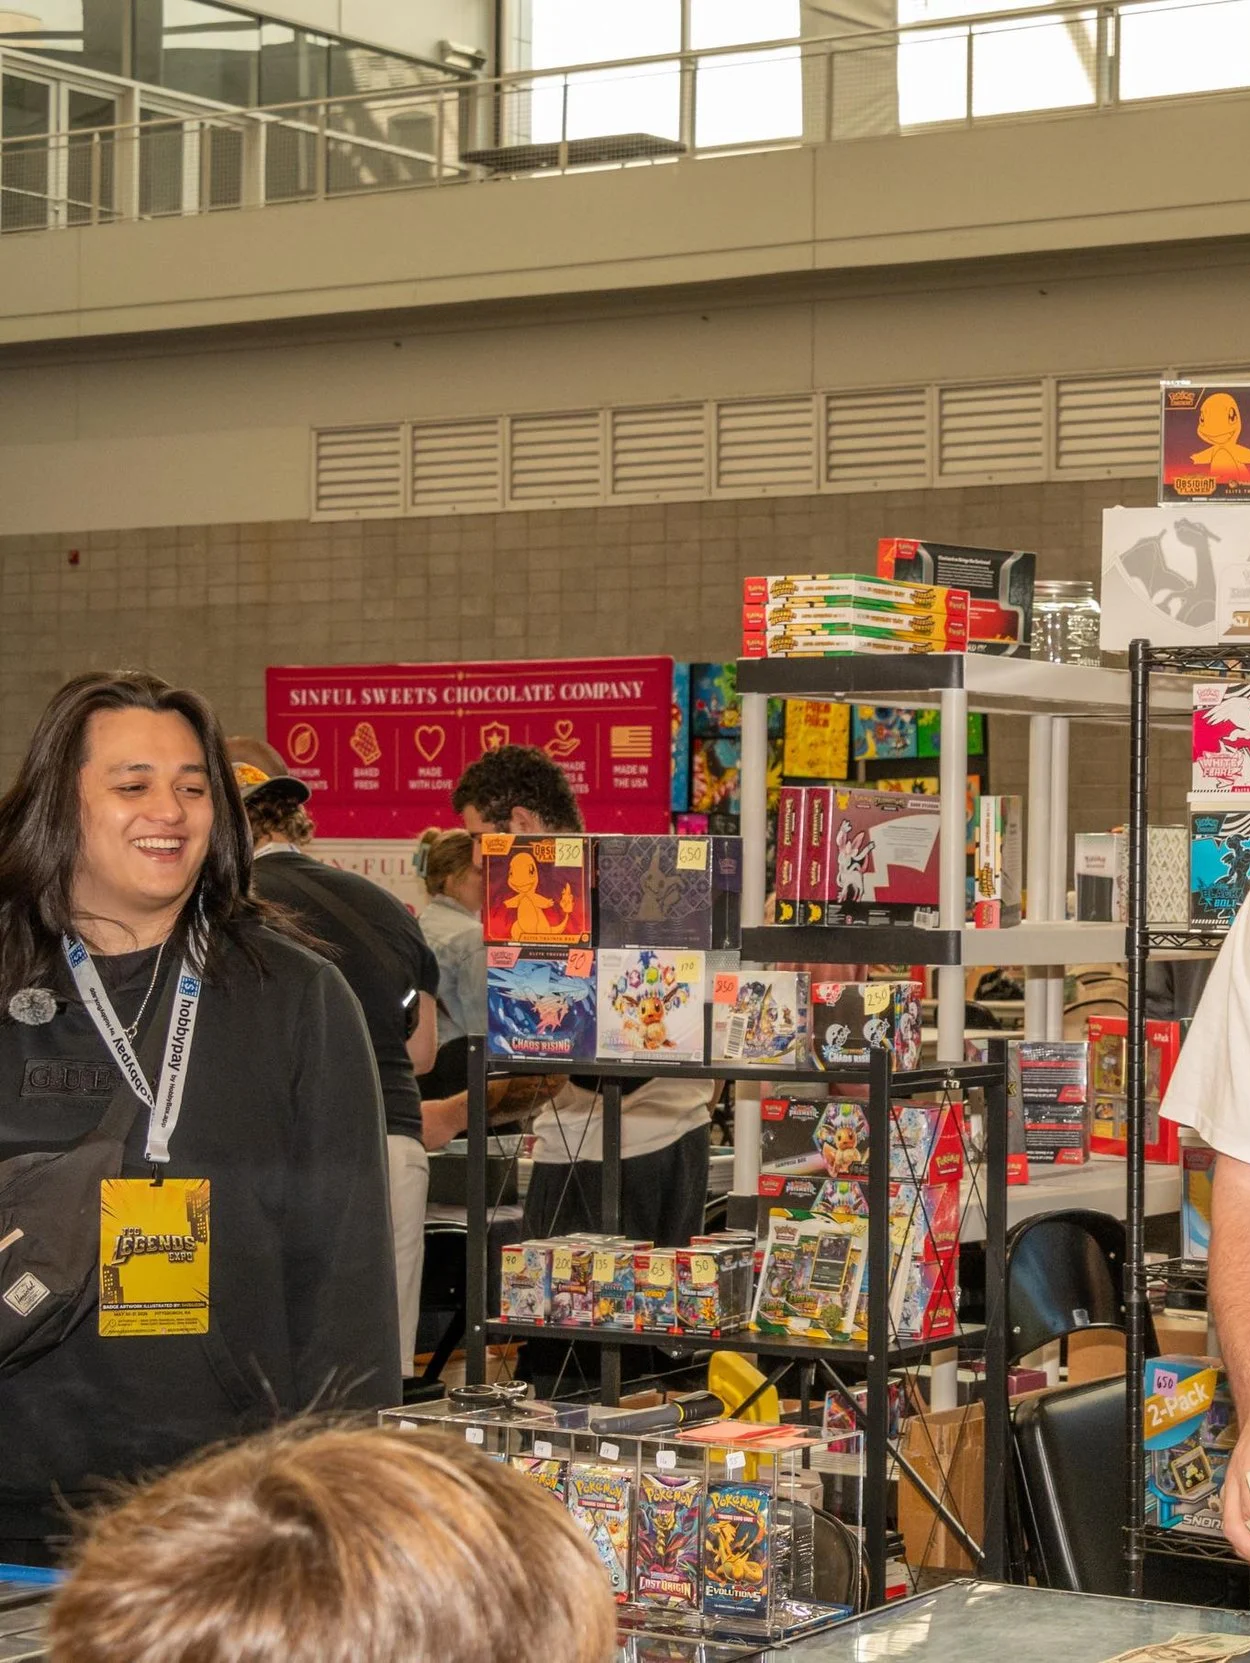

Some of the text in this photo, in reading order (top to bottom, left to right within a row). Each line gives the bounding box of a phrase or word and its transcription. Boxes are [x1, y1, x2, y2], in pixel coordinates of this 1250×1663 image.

[1175, 478, 1215, 489] OBSIDIAN
[289, 679, 644, 707] SINFUL SWEETS CHOCOLATE COMPANY
[613, 764, 649, 775] MADE IN
[1202, 758, 1239, 768] WHITE
[353, 767, 380, 777] BAKED
[418, 766, 442, 777] MADE
[354, 780, 380, 790] FRESH
[613, 778, 649, 788] THE USA
[557, 844, 581, 862] 330
[679, 846, 702, 864] 650
[1213, 898, 1237, 908] BOLT
[866, 991, 889, 1008] 250
[511, 1038, 571, 1052] CHAOS RISING
[160, 999, 195, 1129] hobbypay by HobbyBox.app
[828, 1053, 851, 1063] CHAOS
[111, 1235, 197, 1266] LEGENDS
[167, 1251, 194, 1263] EXPO
[694, 1260, 709, 1274] 50
[1156, 1376, 1174, 1389] 650
[1147, 1382, 1210, 1427] 2-Pack
[645, 1488, 694, 1507] Pokémon
[710, 1492, 760, 1512] Pokémon
[639, 1577, 692, 1599] LOST ORIGIN
[705, 1584, 761, 1602] EVOLUTIONS
